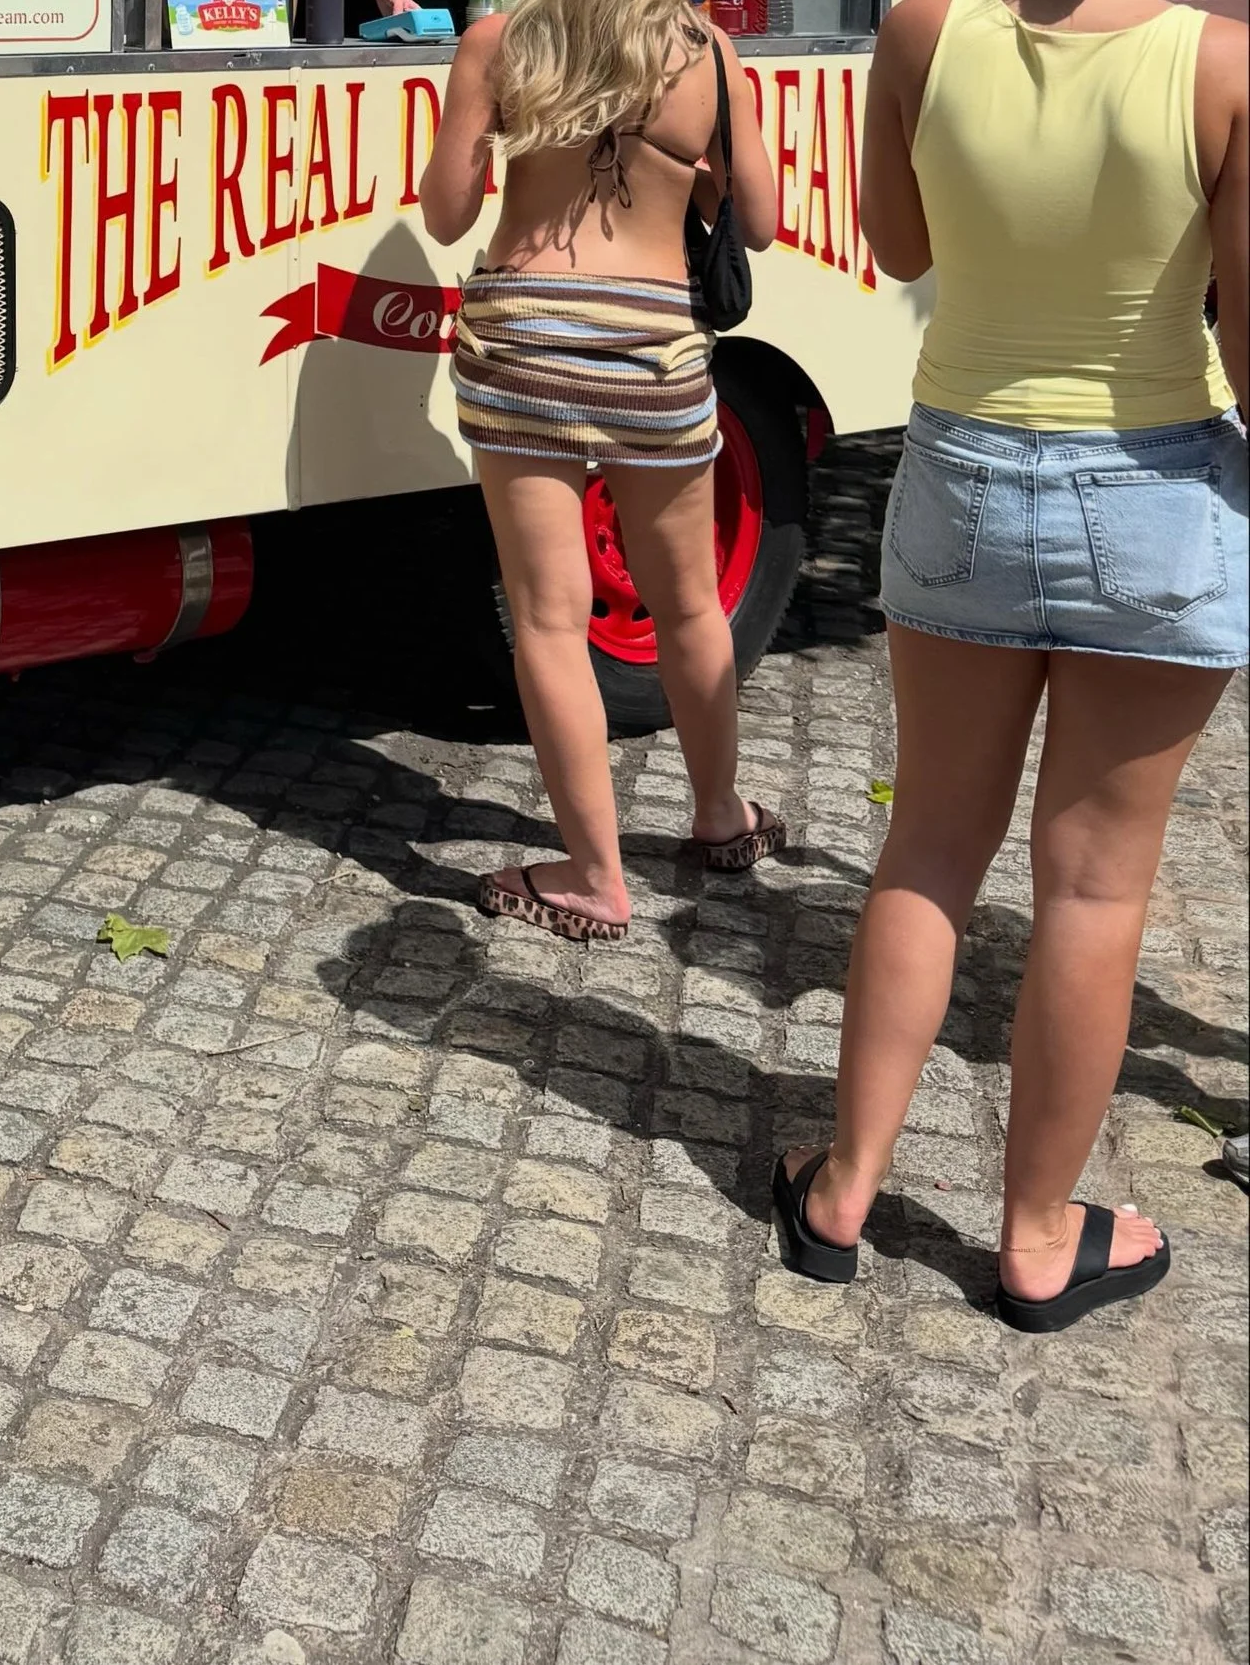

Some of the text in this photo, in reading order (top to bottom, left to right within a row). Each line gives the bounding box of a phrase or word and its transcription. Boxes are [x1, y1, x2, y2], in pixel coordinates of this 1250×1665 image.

[202, 6, 258, 22] KELLY'S
[40, 88, 182, 375] THE
[204, 80, 376, 282] REAL
